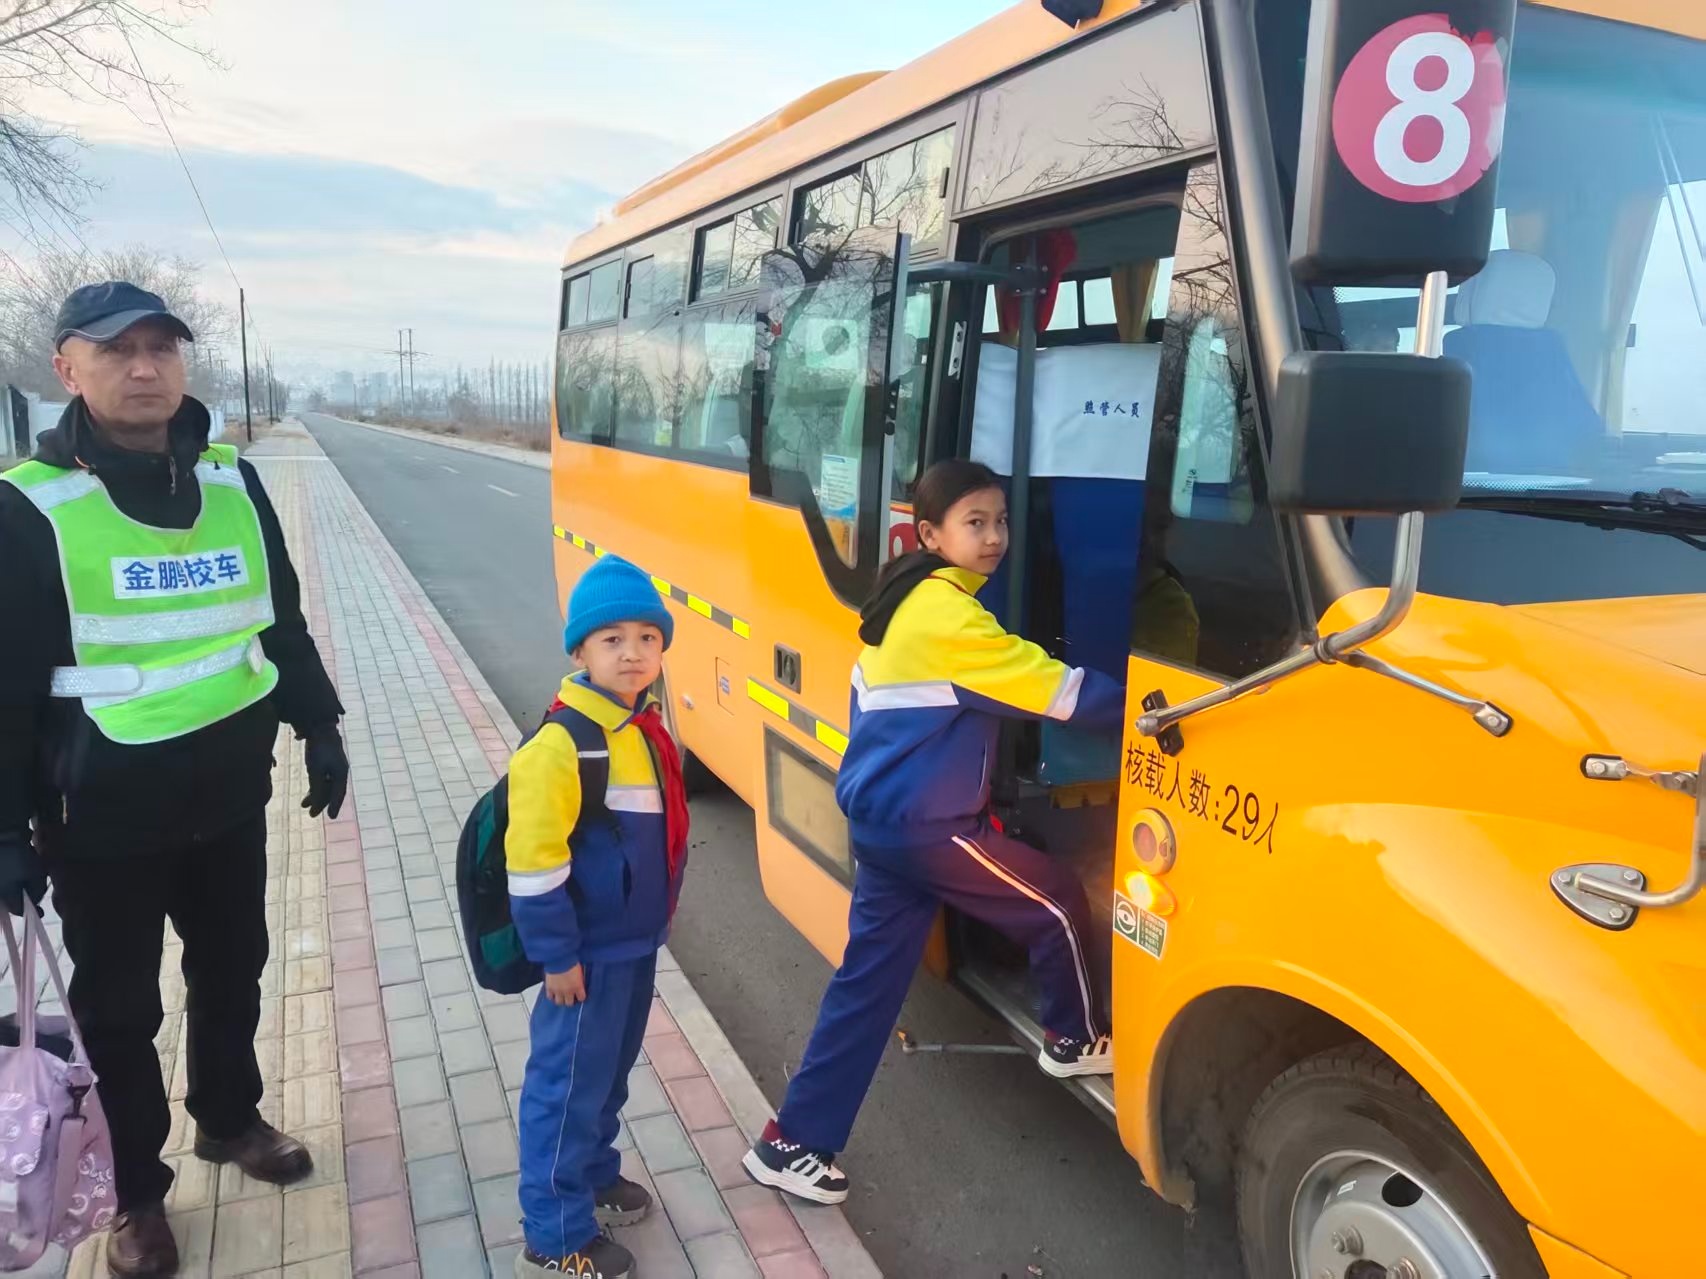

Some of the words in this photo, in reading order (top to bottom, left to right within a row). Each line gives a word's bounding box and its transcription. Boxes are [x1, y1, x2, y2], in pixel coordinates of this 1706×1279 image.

[1374, 32, 1475, 186] 8
[1083, 400, 1139, 418] 监管人员
[122, 553, 241, 590] 金鹏校车
